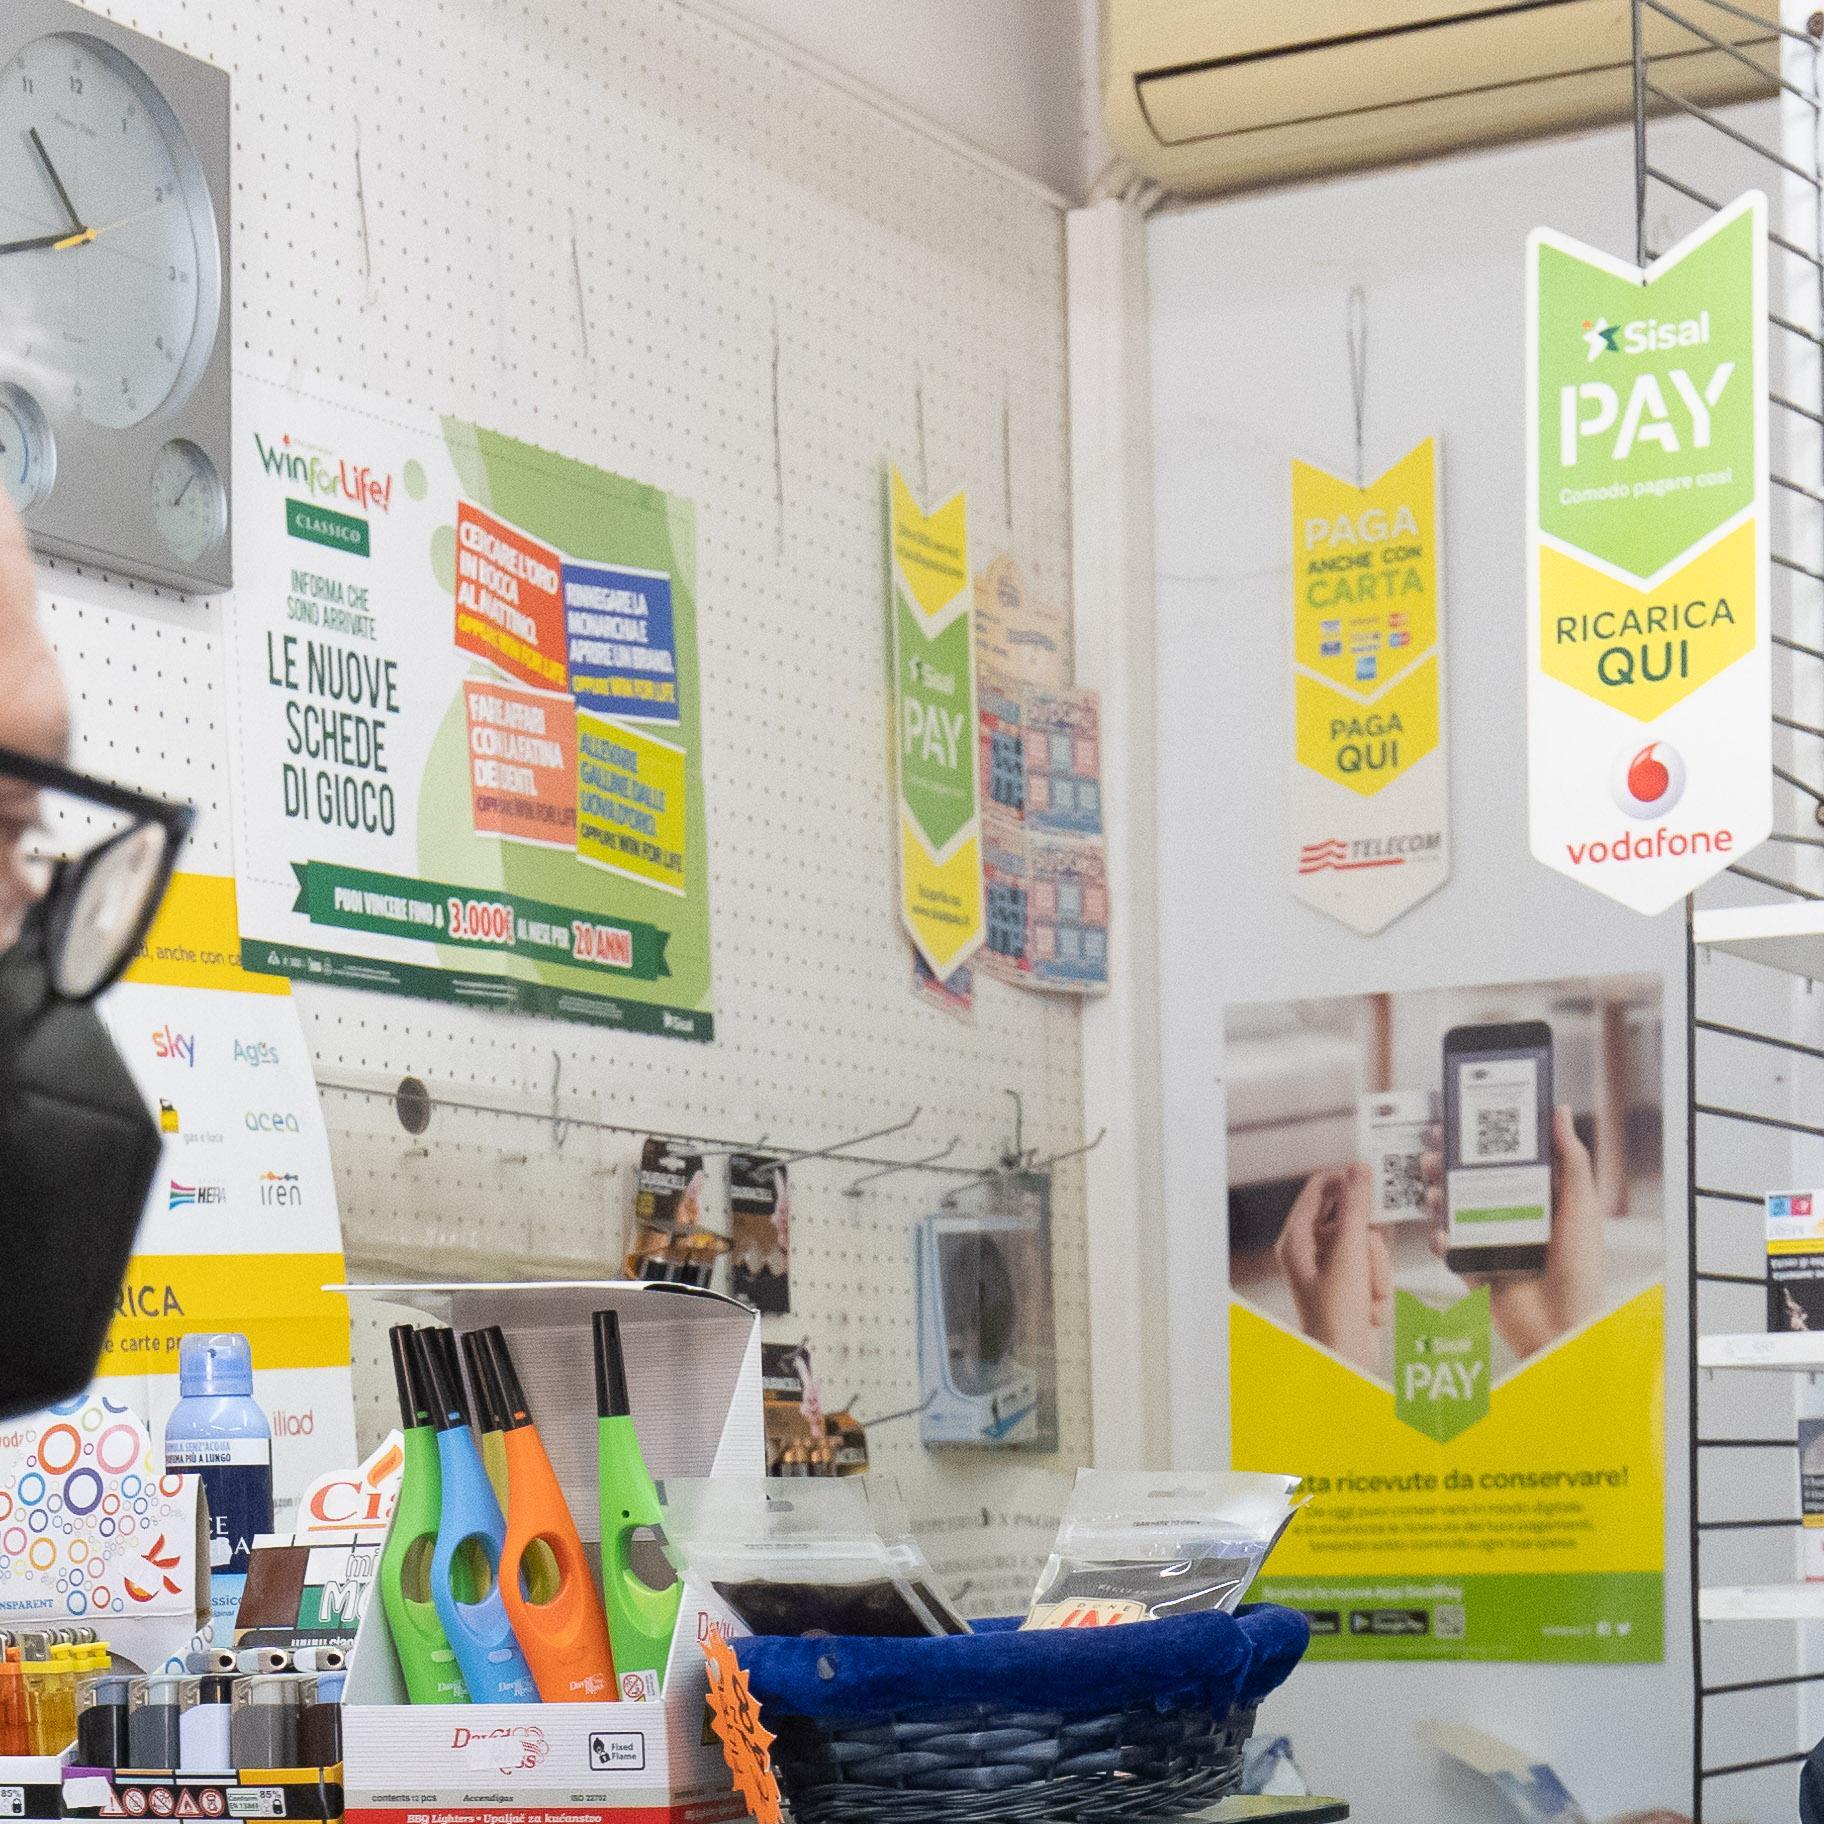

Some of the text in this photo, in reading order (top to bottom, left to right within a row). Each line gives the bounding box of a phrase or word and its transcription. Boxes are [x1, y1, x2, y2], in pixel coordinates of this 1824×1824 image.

[1624, 309, 1710, 353] Sisal
[1560, 361, 1736, 466] PAY
[1560, 472, 1693, 506] Comodo pagare
[295, 513, 361, 543] CLASSICO
[1305, 504, 1418, 550] PAGA
[1308, 545, 1423, 575] ANCHE CON
[291, 569, 369, 612] INFORMA CHE
[1307, 566, 1424, 608] CARTA
[287, 595, 377, 641] SONO ARRIVATE
[1556, 597, 1735, 646] RICARICA
[267, 632, 399, 714] LE NUOVE
[1597, 639, 1689, 688] QUI
[286, 701, 388, 773] SCHEDE
[902, 700, 965, 769] PAY
[1331, 712, 1402, 741] PAGA
[1336, 744, 1398, 774] QUI
[284, 763, 396, 837] DI GIOCO
[1352, 831, 1442, 857] TELECOM
[1567, 825, 1734, 867] vodafone
[152, 1024, 195, 1067] sky
[245, 1111, 299, 1132] acea
[120, 1337, 160, 1353] carte
[1405, 1361, 1483, 1403] PAY
[273, 1409, 314, 1437] iliad
[205, 1453, 231, 1463] LUNGO
[1336, 1465, 1629, 1493] ricevute da conservare!
[611, 1742, 634, 1752] Fixed
[611, 1751, 637, 1761] Flame
[431, 1812, 603, 1824] Lighters Upaljač kućanstvo
